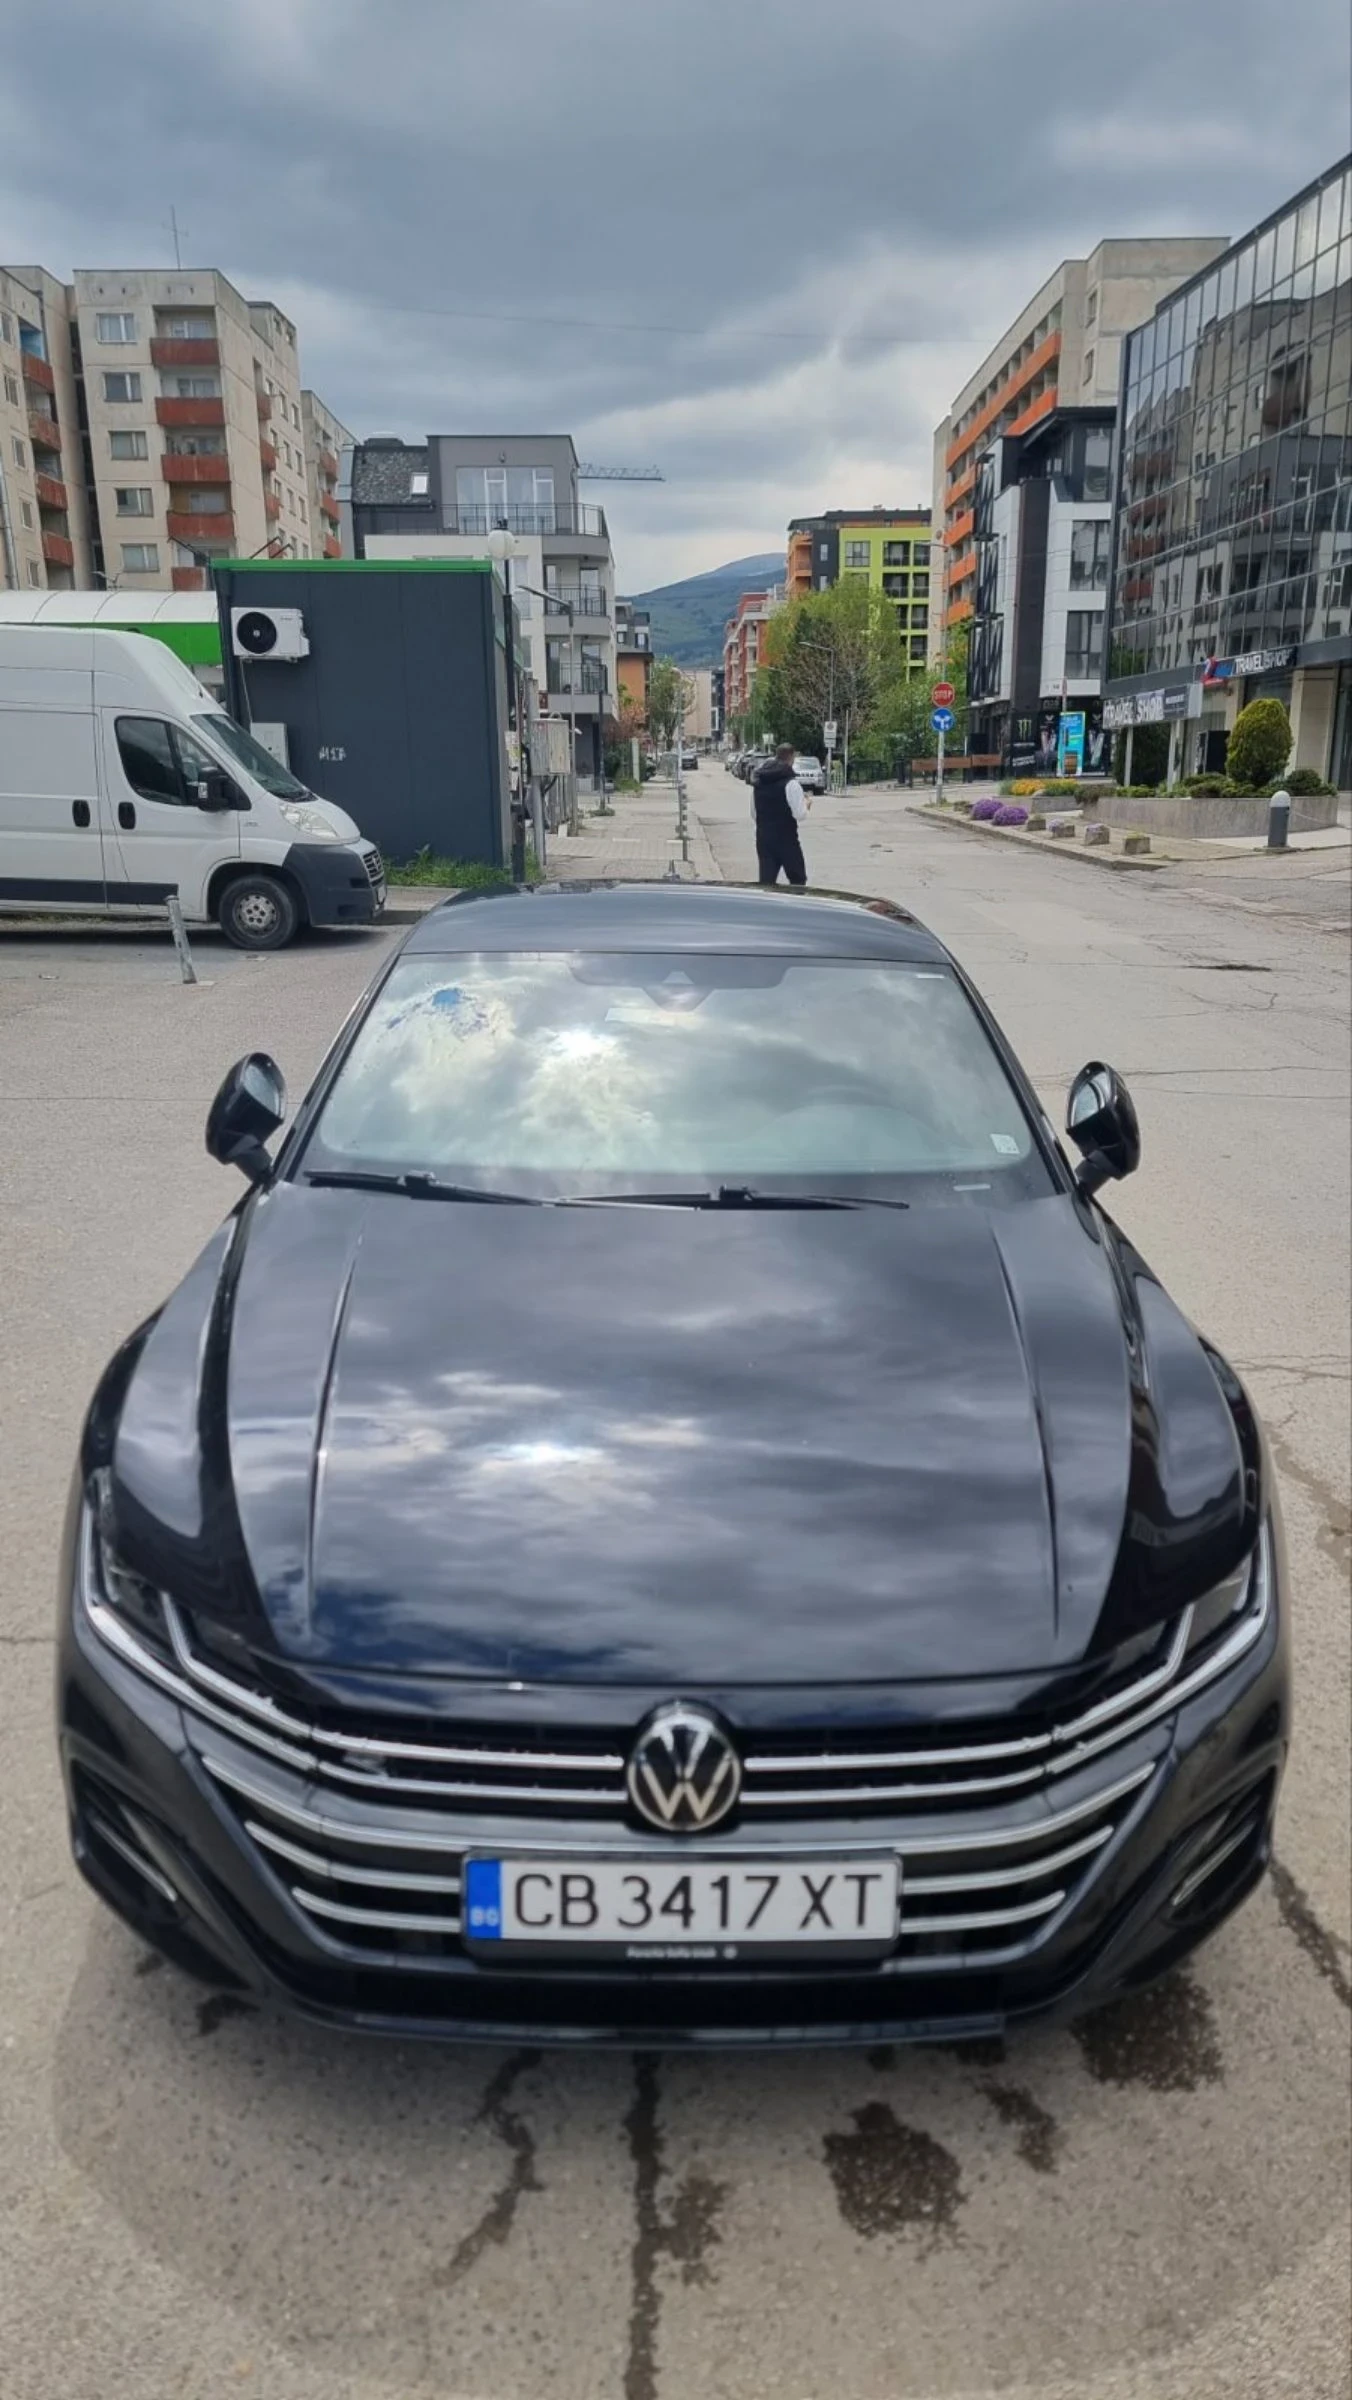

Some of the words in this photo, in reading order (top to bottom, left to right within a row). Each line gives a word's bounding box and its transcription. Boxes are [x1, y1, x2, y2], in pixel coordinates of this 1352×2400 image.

[1235, 654, 1264, 675] TRAVEL
[934, 690, 953, 700] STOP
[515, 1874, 600, 1929] CB
[617, 1875, 780, 1930] 3417
[800, 1874, 882, 1929] XT
